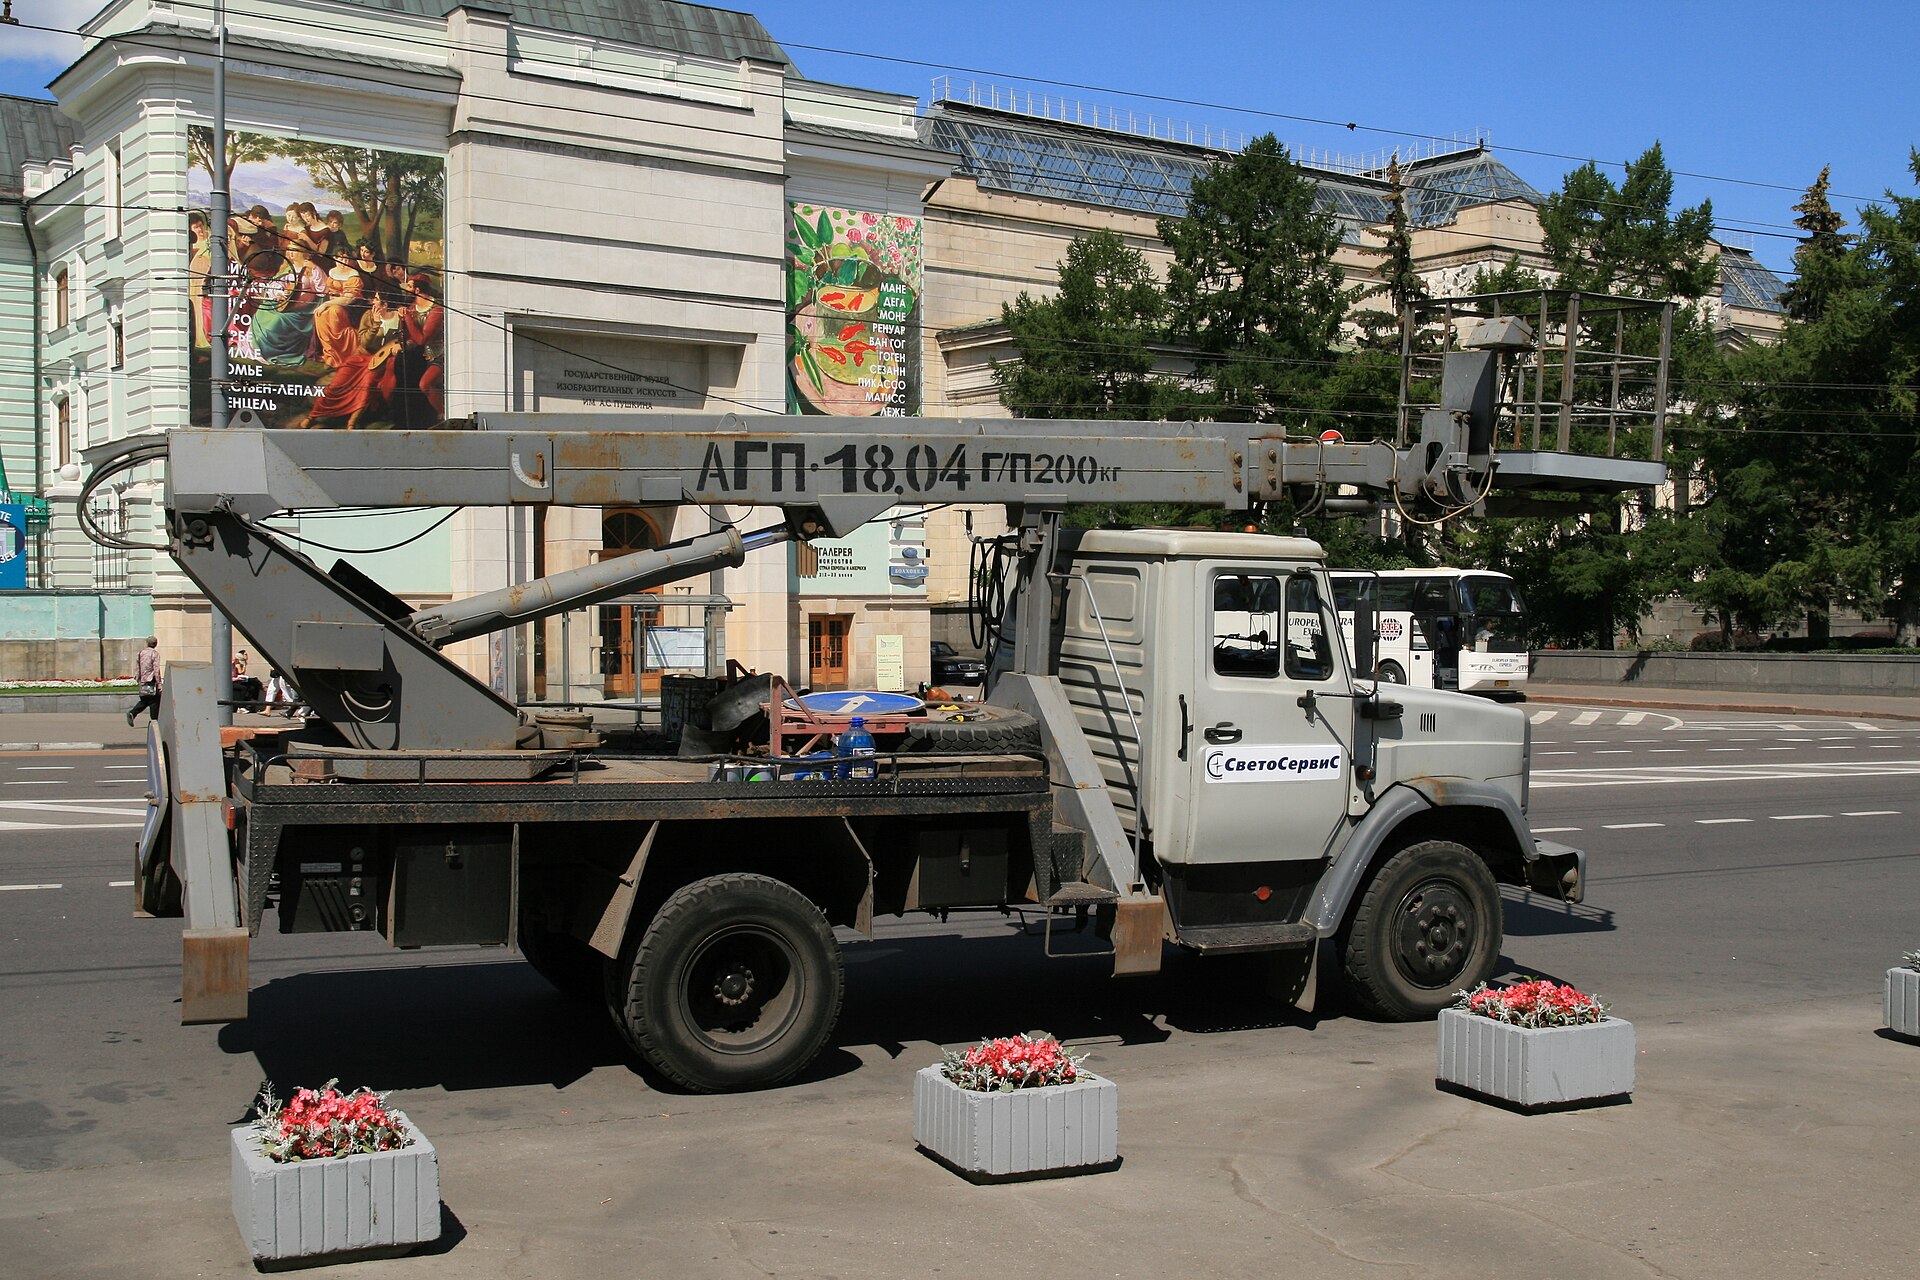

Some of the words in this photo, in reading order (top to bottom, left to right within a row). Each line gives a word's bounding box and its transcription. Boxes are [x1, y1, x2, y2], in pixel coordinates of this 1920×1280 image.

[880, 282, 907, 294] МАНЕ
[883, 296, 906, 308] ДЕГА
[233, 313, 252, 326] РО
[880, 310, 906, 322] МОНЕ
[872, 323, 905, 335] РЕНУАР
[869, 337, 887, 348] ВАН
[890, 338, 906, 349] ГОГ
[879, 351, 906, 363] ГОГЕН
[228, 362, 263, 377] ОМЬЕ
[564, 369, 642, 382] ГОСУДАРСТВЕННЫЙ
[870, 364, 906, 377] СЕЗАНН
[557, 382, 634, 395] ИЗОБРАЗИТЕЛЬНЫХ
[636, 387, 677, 398] ИСКУССТВ
[858, 377, 906, 390] ПИКАССО
[228, 396, 277, 411] ЕНЦЕЛЬ
[865, 391, 906, 404] МАТИСС
[880, 406, 906, 417] ЛЕЖЕ
[818, 547, 853, 557] ГАЛЕРЕЯ
[1224, 755, 1340, 774] СветоСервиС
